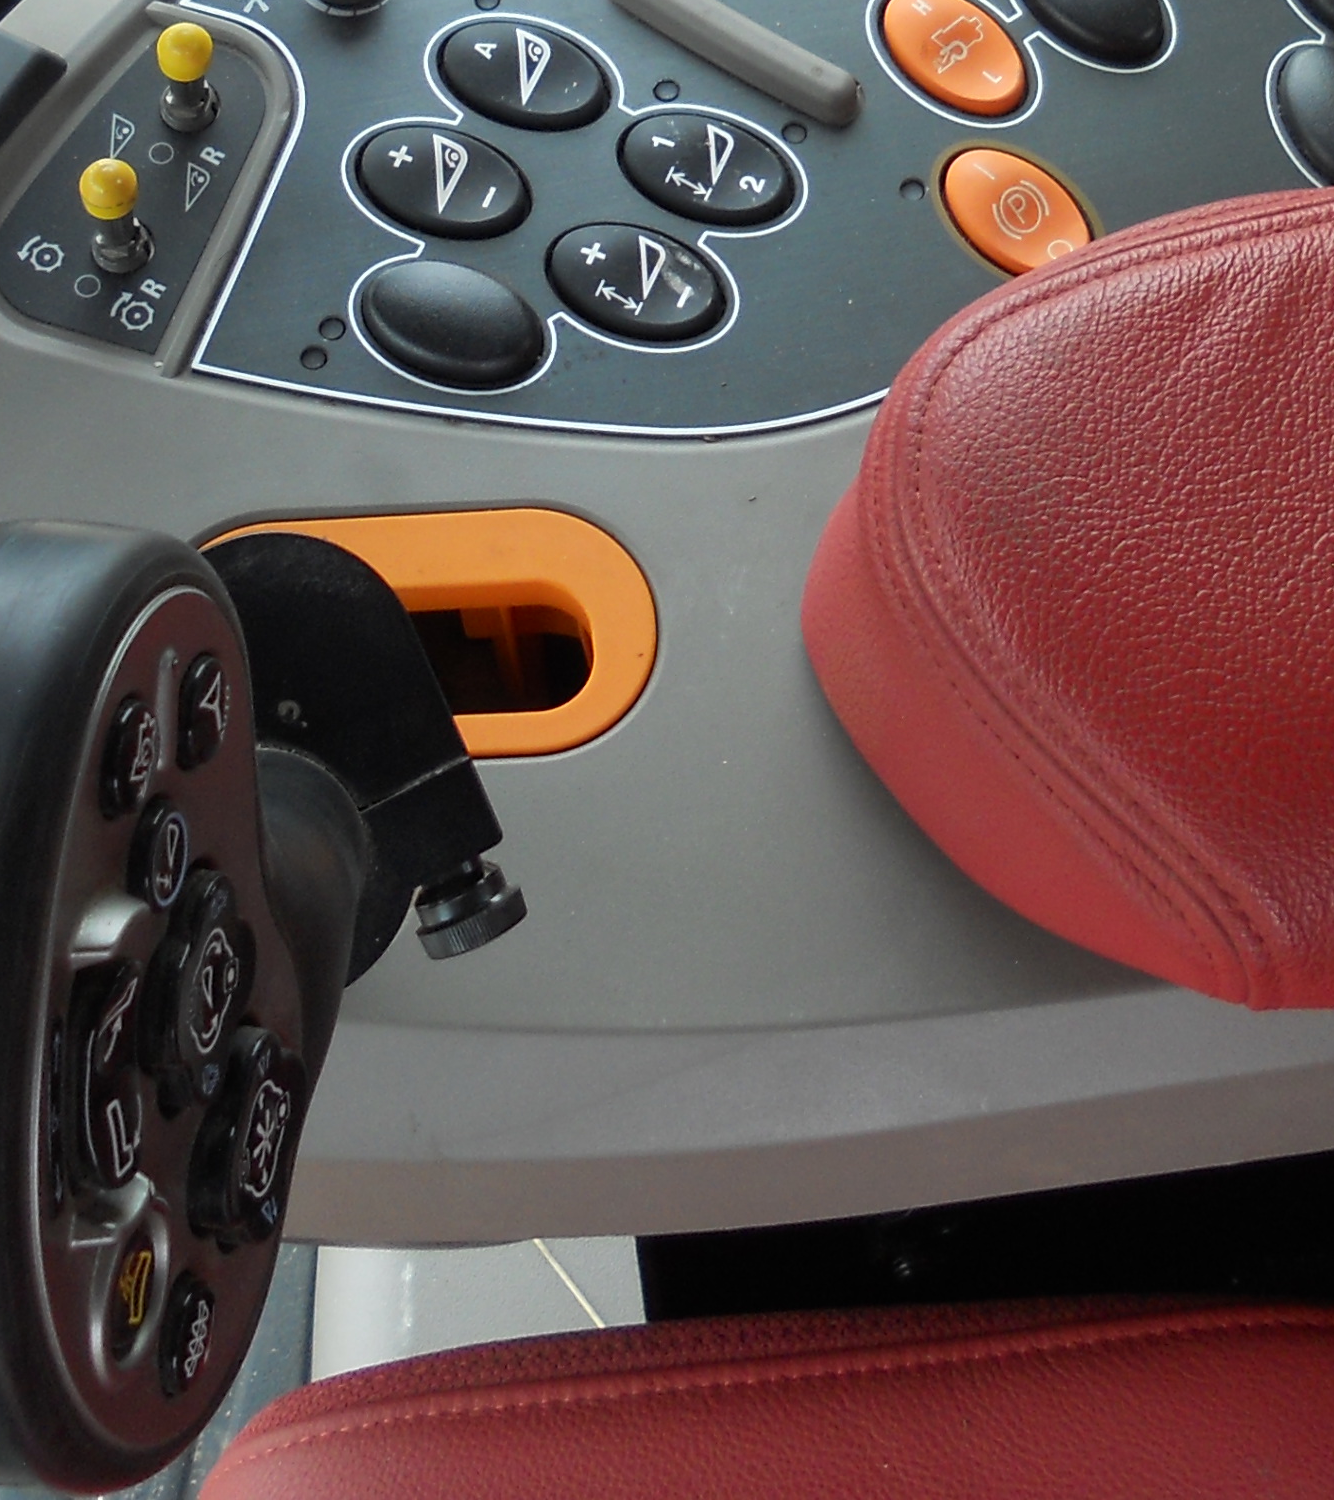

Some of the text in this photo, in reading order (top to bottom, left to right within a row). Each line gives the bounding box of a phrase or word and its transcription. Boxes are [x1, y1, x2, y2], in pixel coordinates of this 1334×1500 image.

[474, 42, 497, 60] A
[982, 71, 1003, 84] L
[651, 135, 675, 148] 1
[200, 146, 226, 166] R
[739, 175, 765, 193] 2
[1007, 193, 1027, 224] P
[140, 278, 167, 299] R
